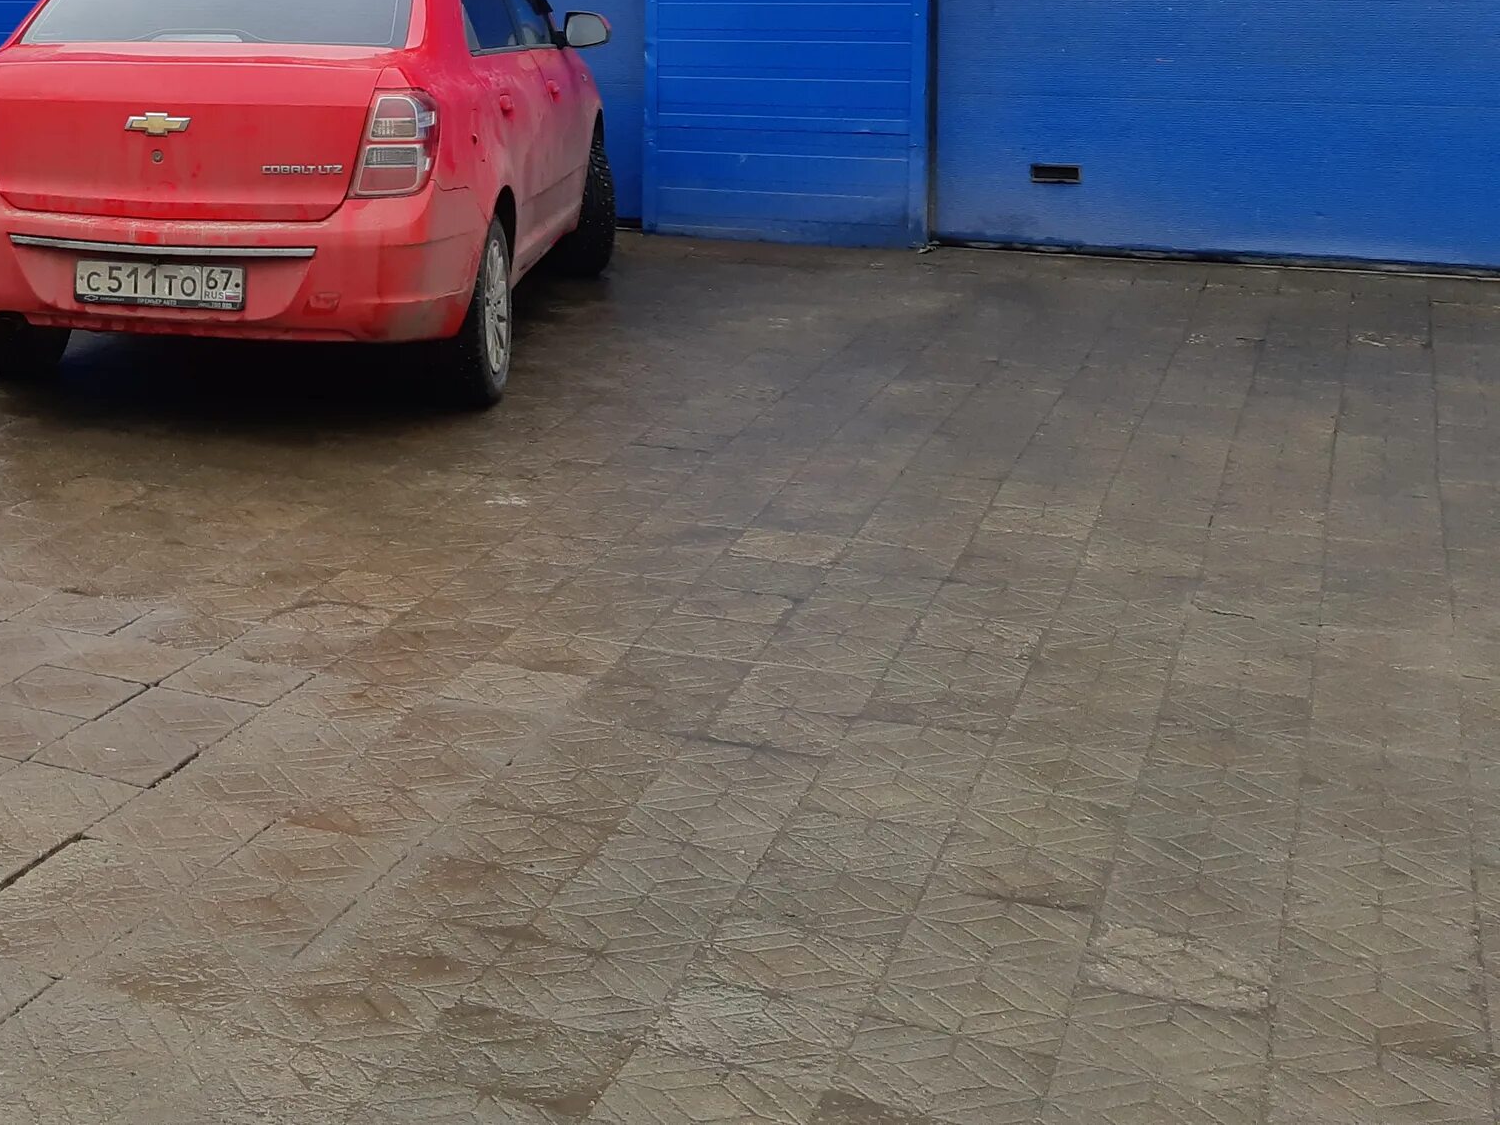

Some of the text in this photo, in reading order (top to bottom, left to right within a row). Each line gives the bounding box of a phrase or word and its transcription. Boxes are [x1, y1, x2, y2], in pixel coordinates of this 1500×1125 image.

[261, 164, 344, 175] COBALT LTZ
[205, 268, 234, 291] 67
[203, 290, 225, 300] RUS
